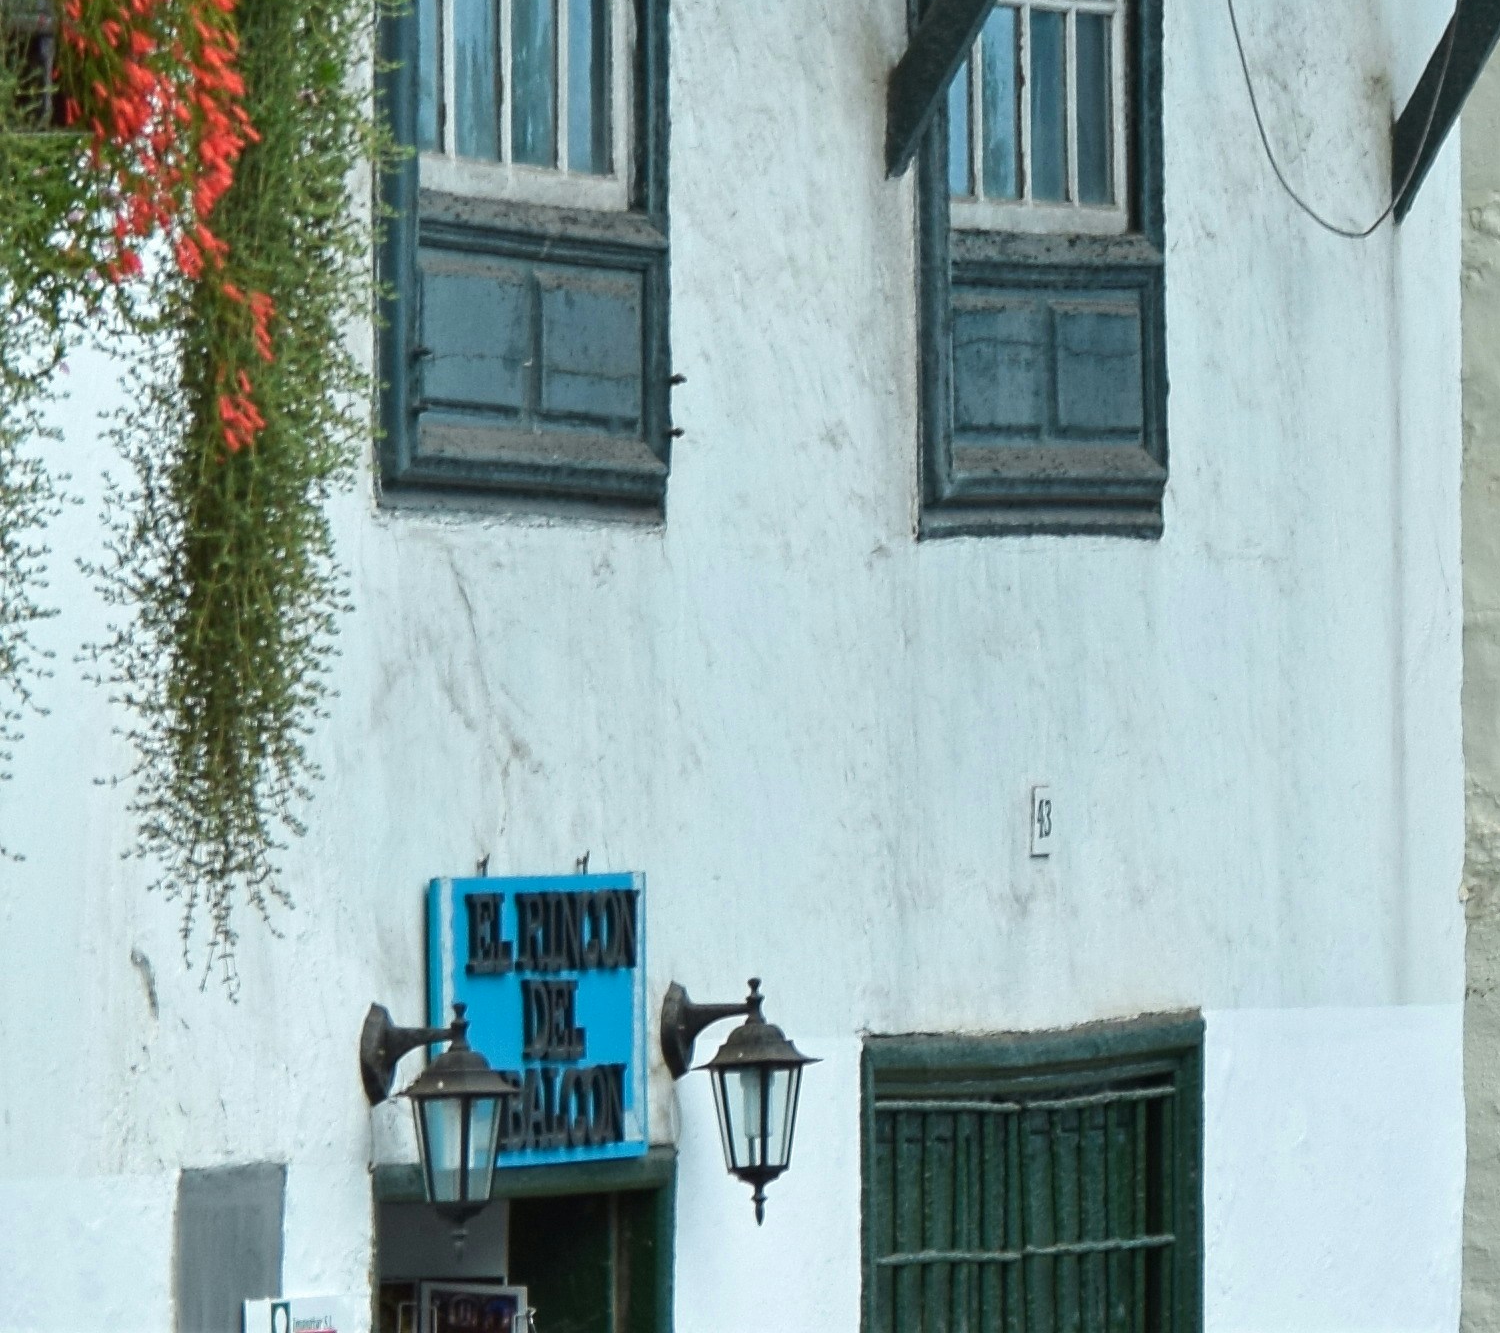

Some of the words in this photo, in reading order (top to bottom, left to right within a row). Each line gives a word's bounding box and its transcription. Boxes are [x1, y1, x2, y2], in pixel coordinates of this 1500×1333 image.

[1037, 799, 1052, 839] 43
[465, 892, 513, 973] EL
[514, 889, 640, 970] RINCON
[521, 979, 586, 1061] DEL
[500, 1063, 627, 1151] BALCON
